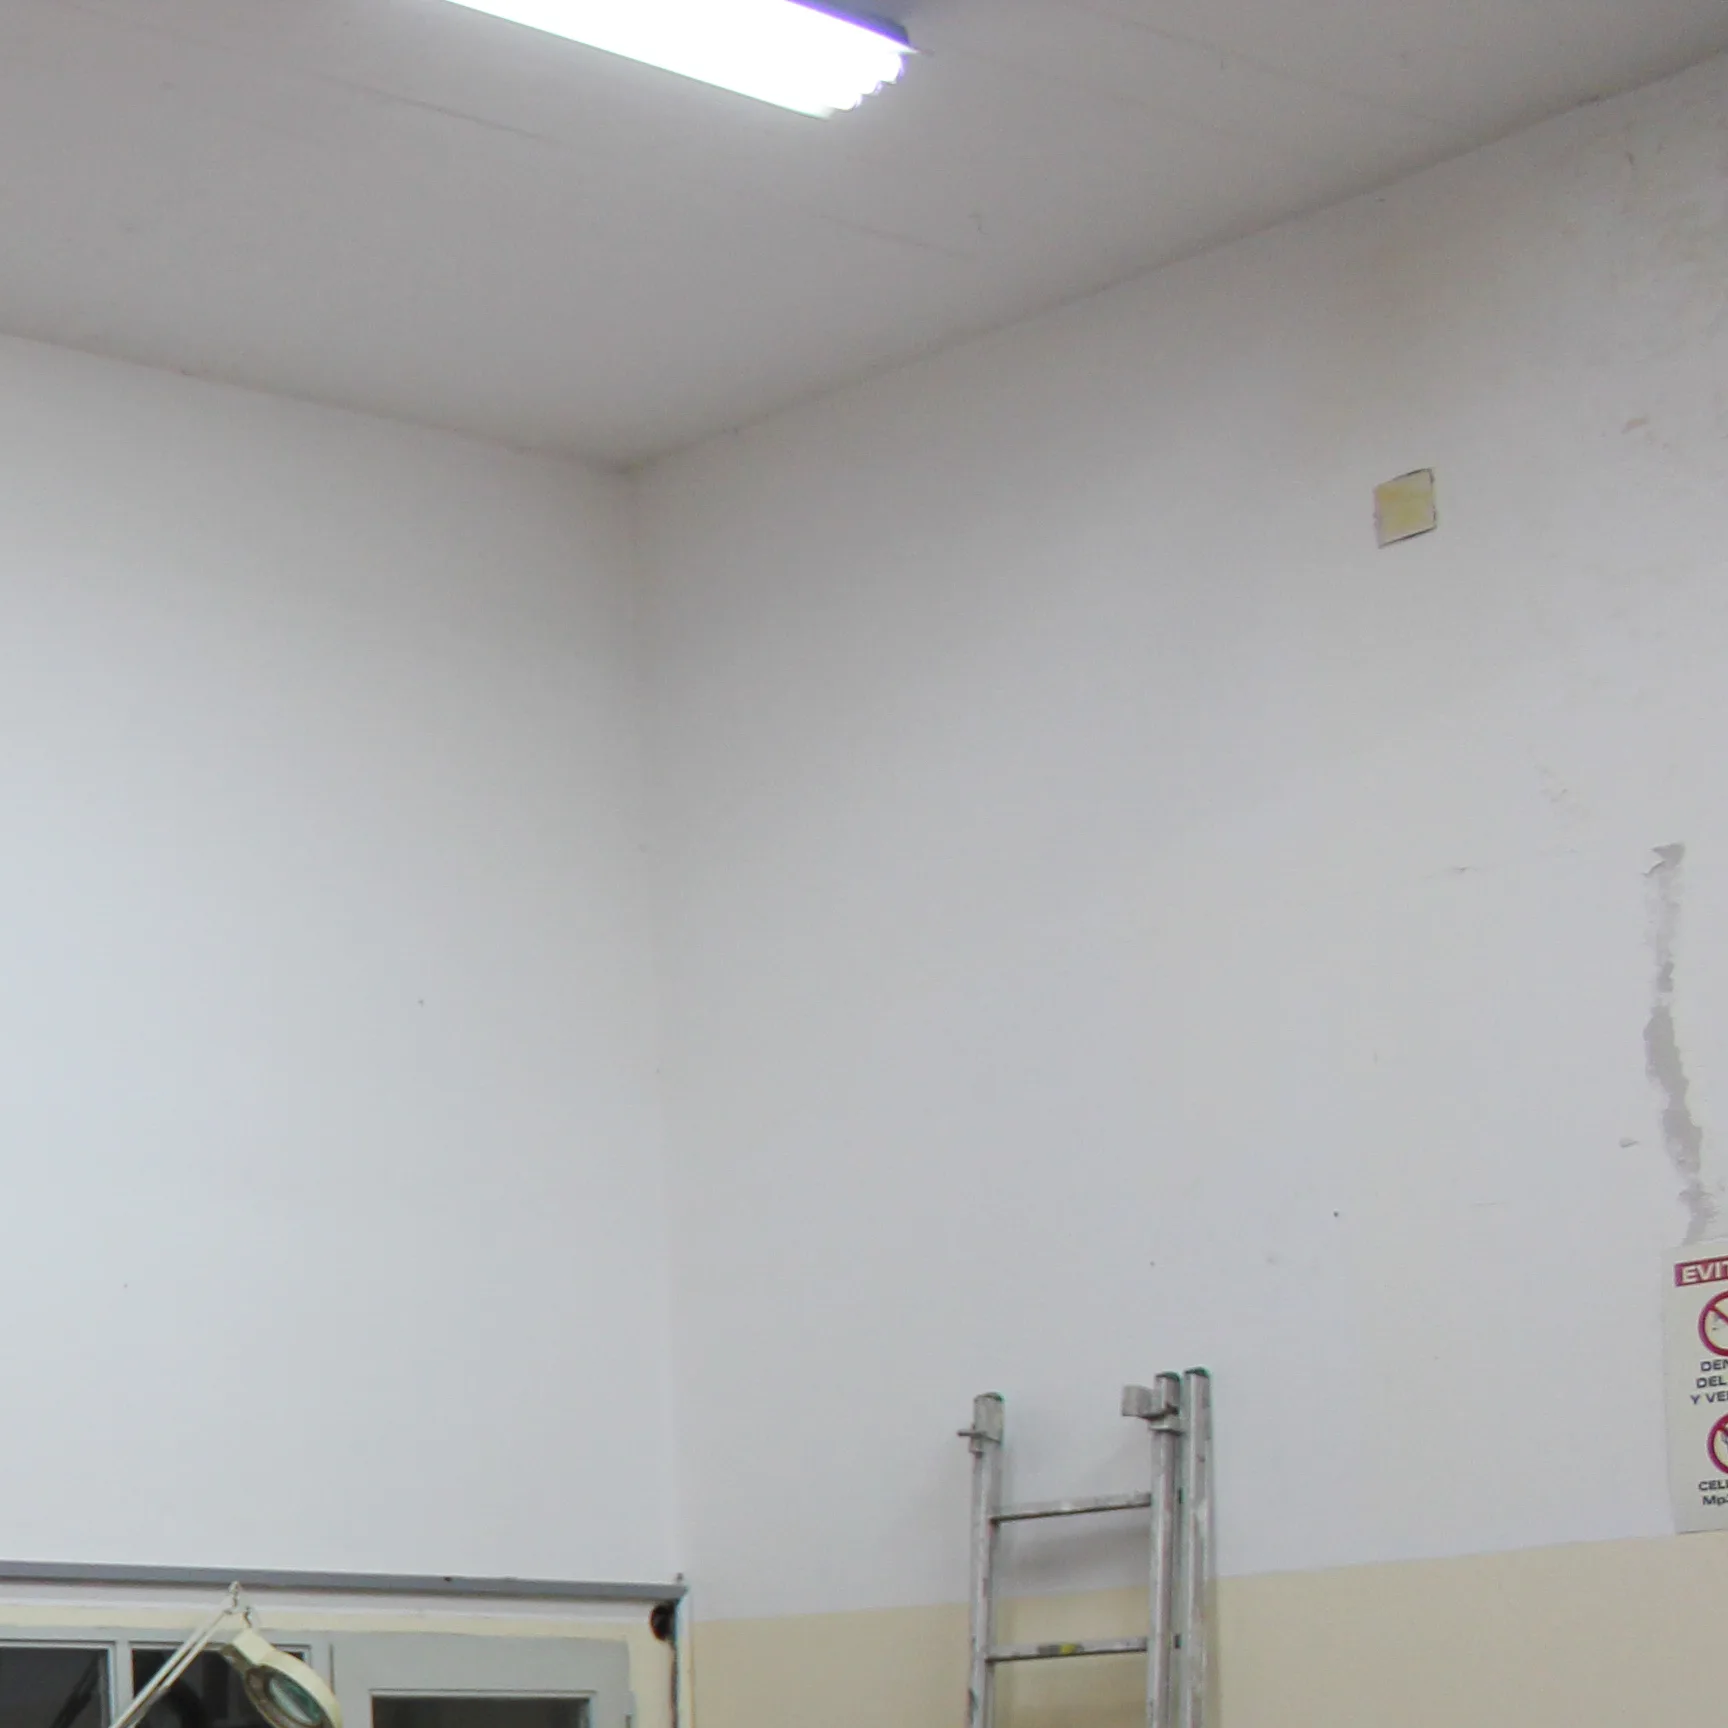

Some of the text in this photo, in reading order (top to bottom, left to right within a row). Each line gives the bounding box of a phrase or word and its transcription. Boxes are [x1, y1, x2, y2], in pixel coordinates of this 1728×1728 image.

[1696, 1376, 1727, 1388] DEL
[1690, 1391, 1728, 1405] Y VE
